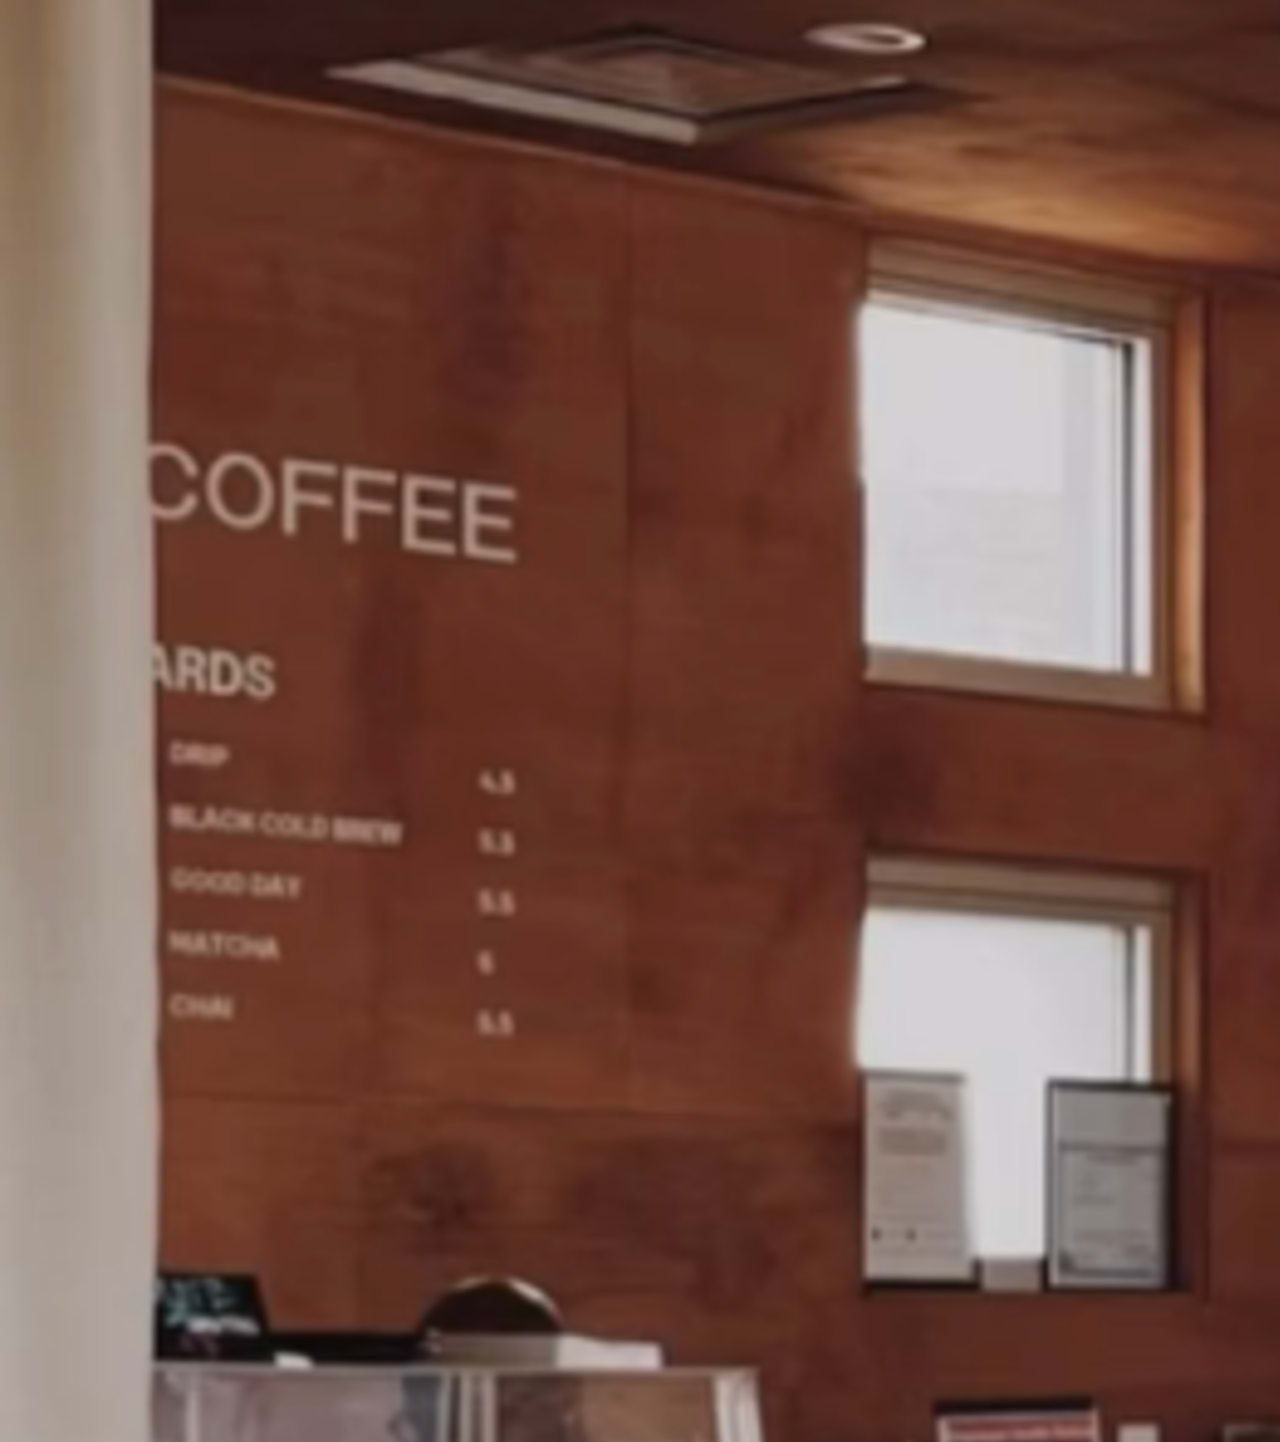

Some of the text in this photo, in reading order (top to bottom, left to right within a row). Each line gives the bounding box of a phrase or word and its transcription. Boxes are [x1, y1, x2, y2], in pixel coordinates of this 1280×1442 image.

[148, 443, 517, 563] COFFEE
[168, 804, 255, 834] BLACK
[260, 811, 329, 841] COLD
[332, 818, 403, 846] BREW
[170, 868, 246, 895] GOOD
[169, 930, 280, 961] MATCHA
